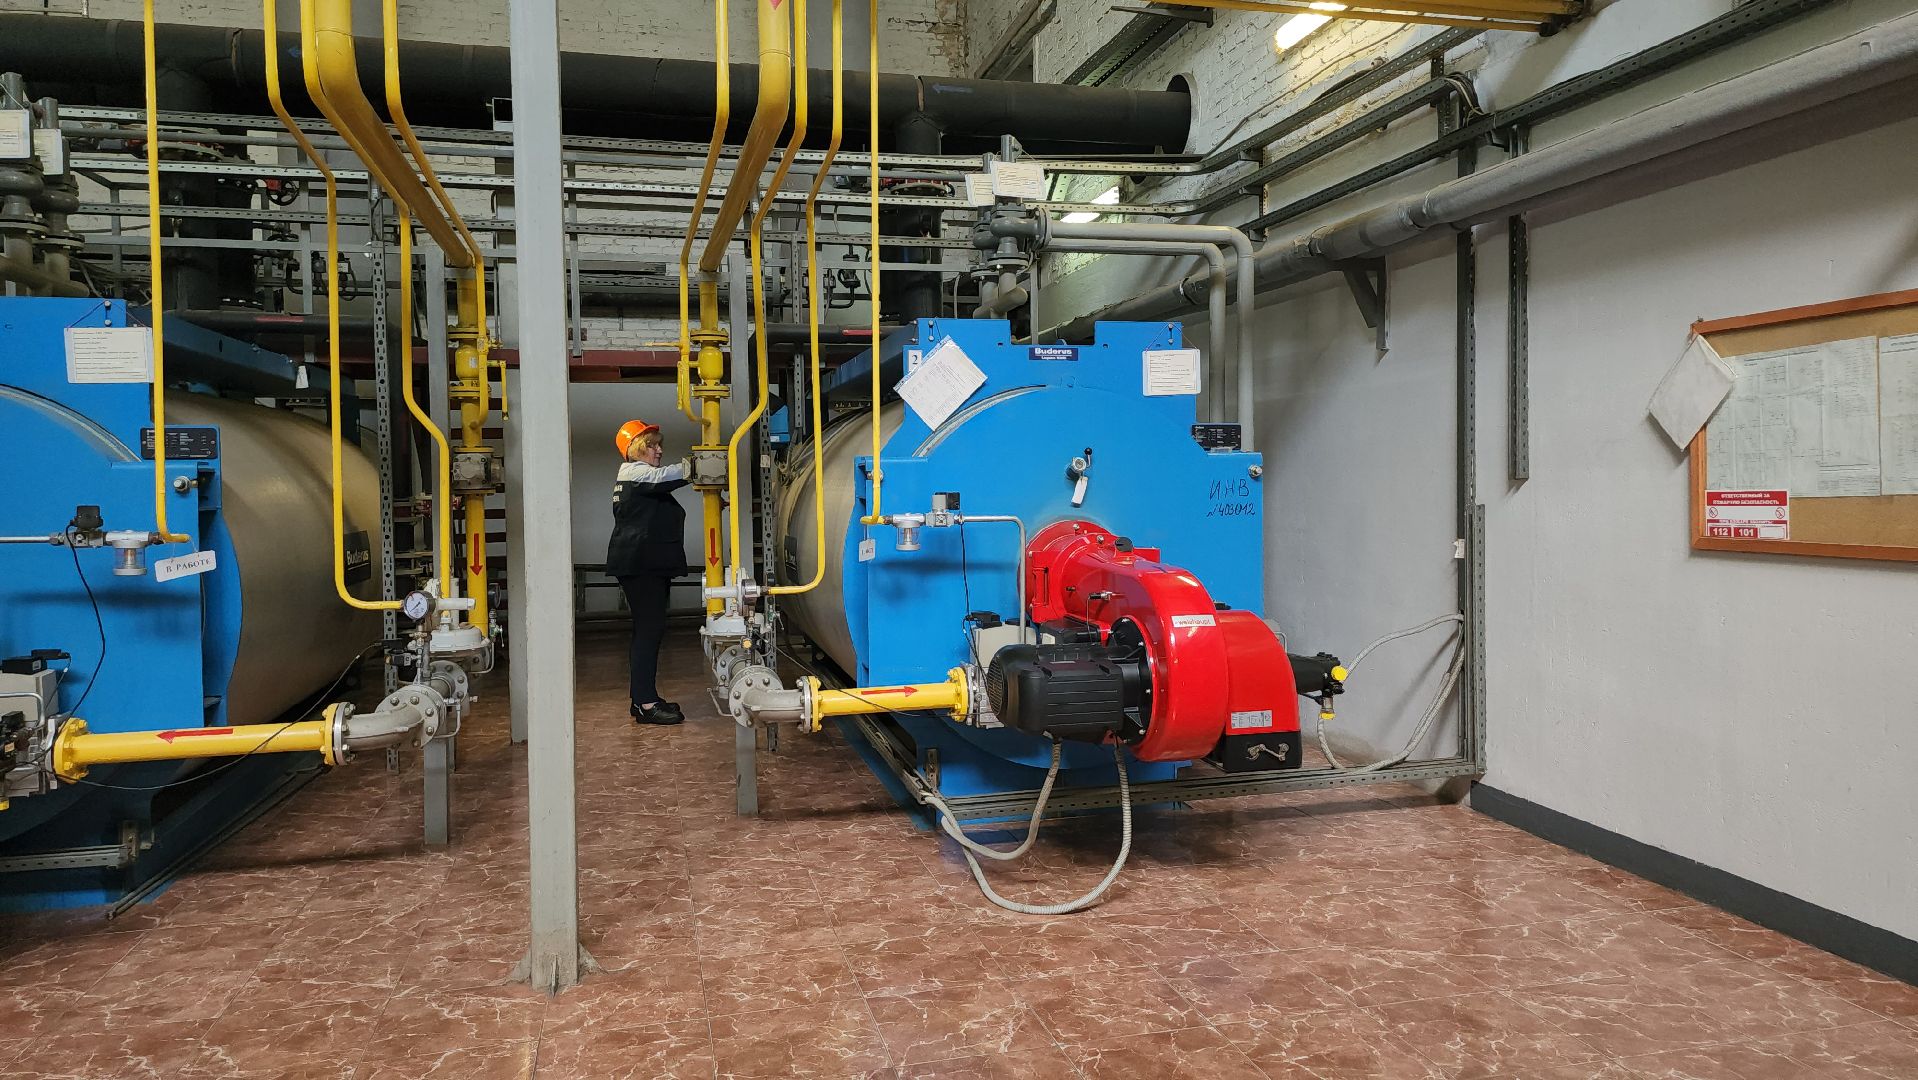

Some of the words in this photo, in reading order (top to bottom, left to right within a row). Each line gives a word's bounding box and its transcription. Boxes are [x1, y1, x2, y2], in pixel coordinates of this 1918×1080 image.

[1034, 347, 1072, 355] Buderus
[911, 354, 919, 366] 2
[1712, 527, 1729, 536] 112
[1738, 528, 1754, 537] 101
[166, 565, 172, 573] В
